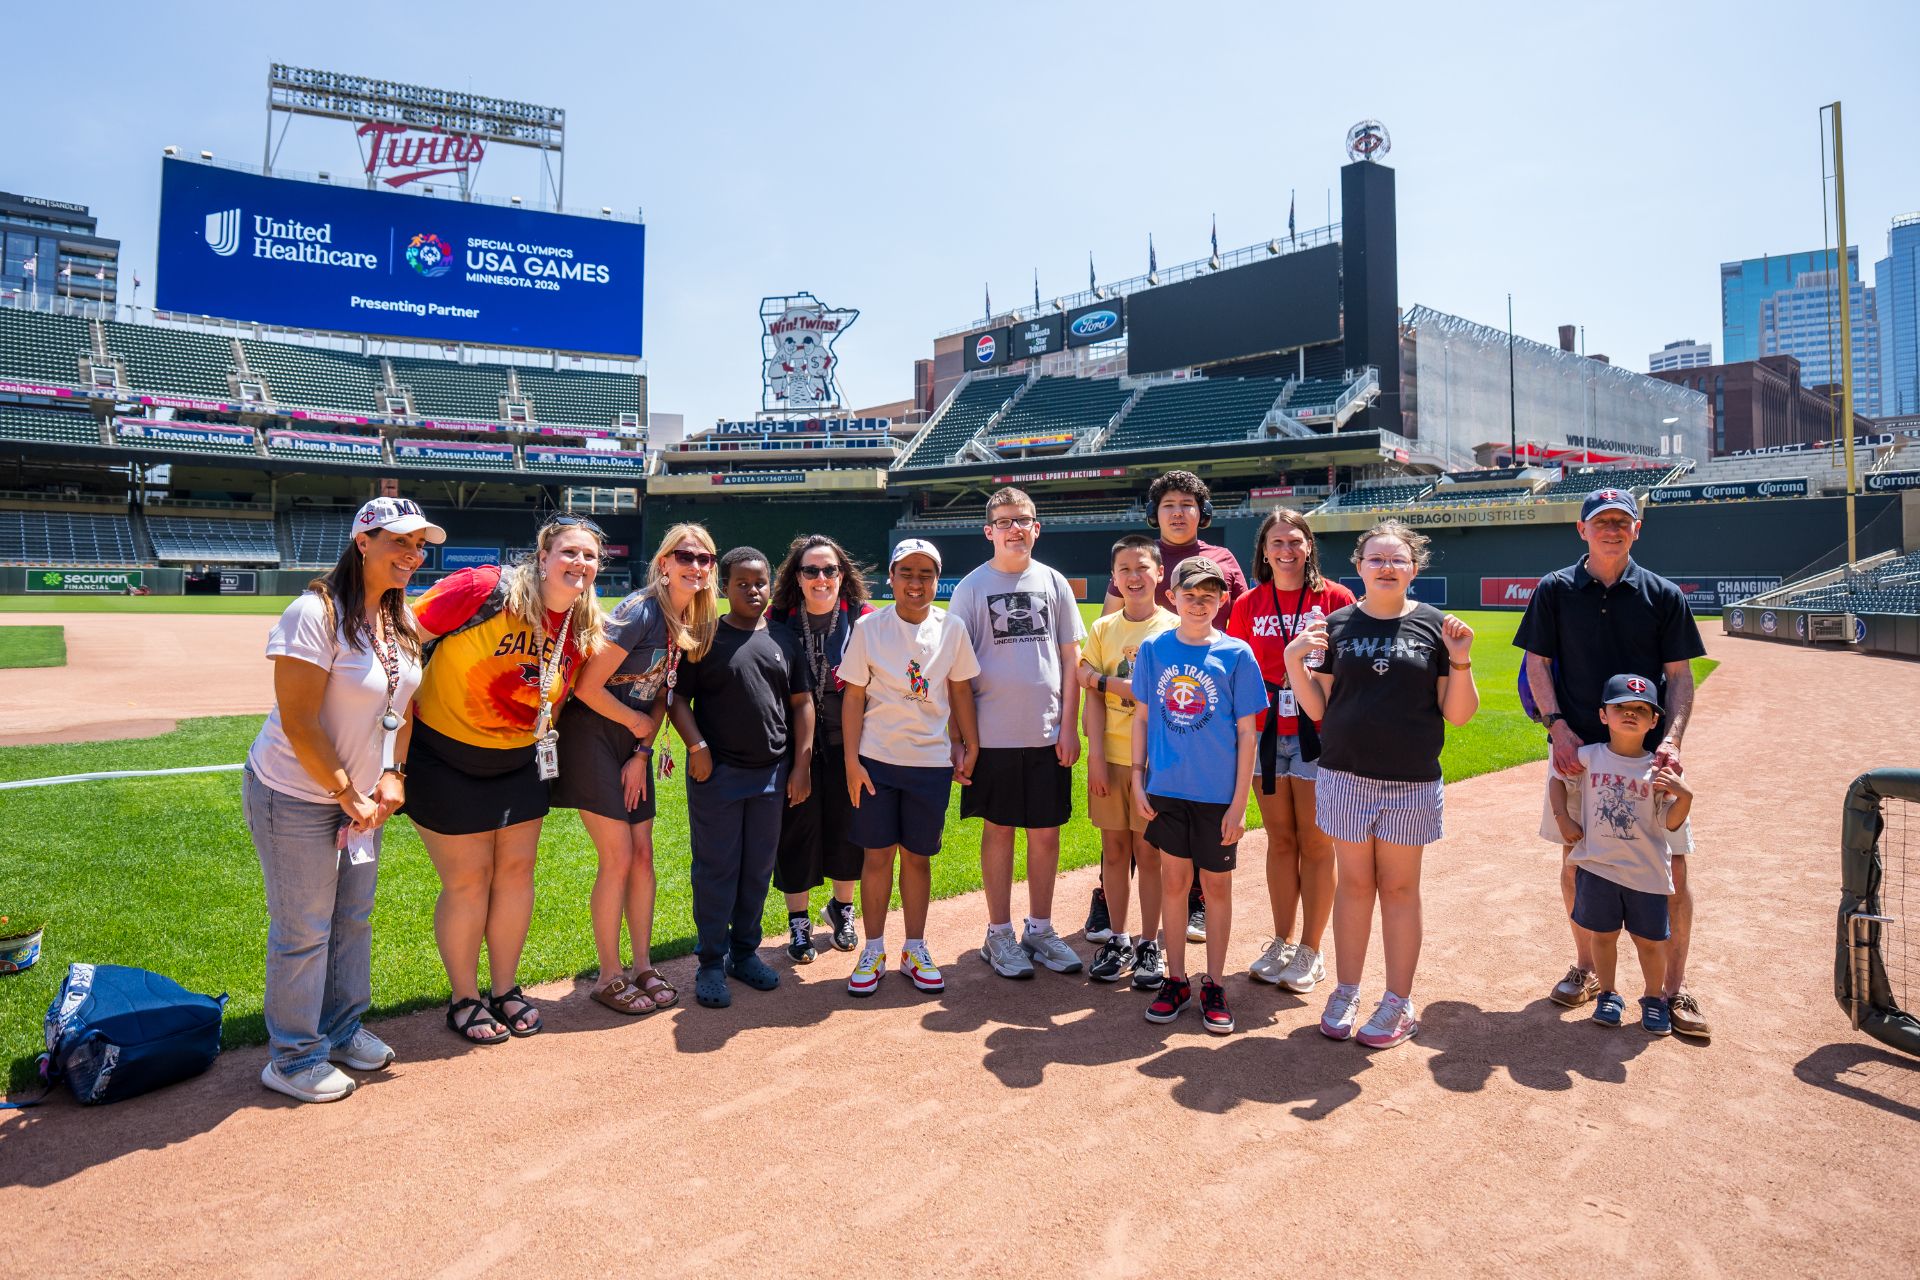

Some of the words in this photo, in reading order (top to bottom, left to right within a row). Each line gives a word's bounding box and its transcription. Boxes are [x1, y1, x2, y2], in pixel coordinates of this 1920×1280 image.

[357, 122, 484, 174] Twins
[253, 214, 332, 244] United
[252, 236, 378, 270] Healthcare
[467, 237, 515, 252] SPECIAL
[517, 243, 574, 259] OLYMPICS
[466, 250, 517, 274] USA
[523, 256, 610, 284] GAMES
[466, 272, 533, 288] MINNESOTA
[534, 279, 560, 291] 2026
[350, 295, 426, 316] Presenting
[428, 303, 480, 318] Partner
[769, 317, 798, 335] Win!
[799, 316, 842, 331] Twins!
[1079, 316, 1109, 333] Ford
[977, 345, 994, 353] PEPSI
[0, 383, 57, 396] casino.com
[150, 397, 191, 409] Treasure
[192, 401, 220, 411] Island
[433, 420, 466, 430] Treasure
[467, 423, 490, 432] Island
[719, 420, 799, 434] TARGET
[824, 417, 891, 431] FIELD
[150, 428, 206, 442] Treasure
[207, 433, 245, 445] Island
[1823, 432, 1895, 447] FELD
[294, 440, 328, 452] Home
[352, 445, 380, 456] Deck
[426, 448, 471, 459] Treasure
[559, 455, 588, 465] Home
[610, 458, 634, 467] Deck
[1650, 488, 1692, 502] Corona
[1702, 485, 1746, 499] Corona
[1757, 482, 1804, 497] Corona
[1452, 509, 1536, 524] INDUSTRIES
[64, 574, 128, 584] securian
[1504, 584, 1536, 599] Kw
[1717, 582, 1777, 593] CHANGING
[1252, 623, 1305, 637] MATTE
[993, 638, 1018, 646] UNDER
[494, 630, 573, 684] SABES
[1156, 664, 1180, 697] SPRING
[1183, 663, 1219, 704] TRAINING
[1590, 772, 1649, 798] TEXAS
